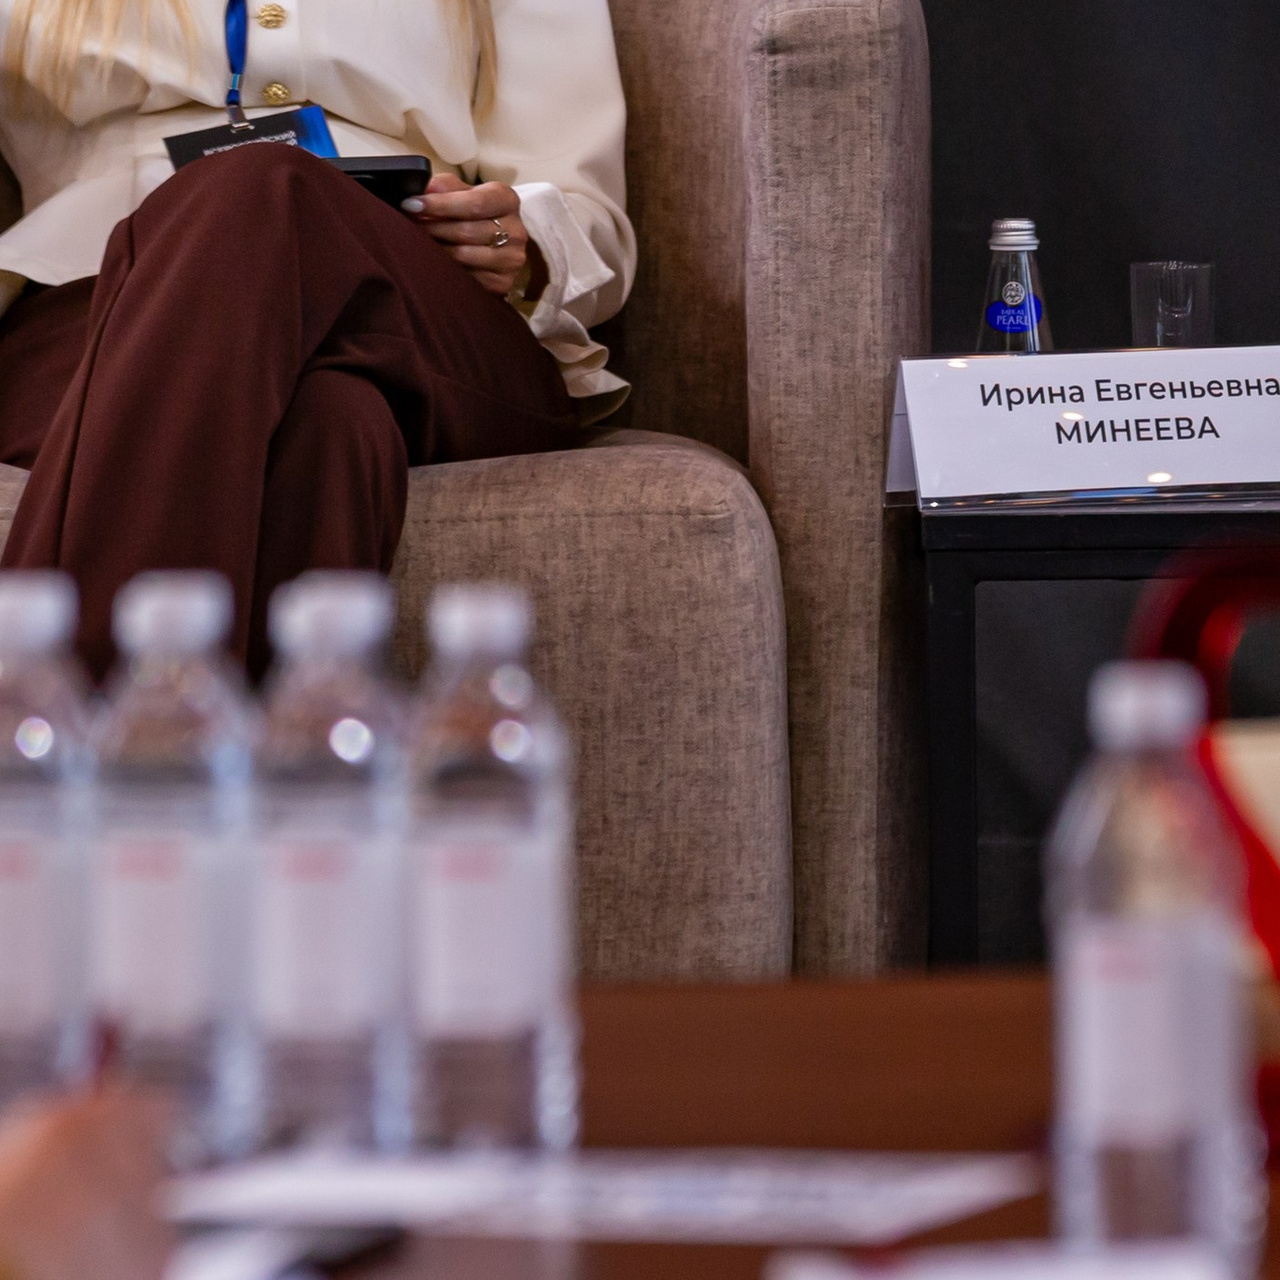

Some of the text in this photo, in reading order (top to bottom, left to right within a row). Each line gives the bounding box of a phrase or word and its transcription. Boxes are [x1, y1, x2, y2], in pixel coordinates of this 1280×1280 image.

[996, 314, 1029, 326] PEARL
[979, 377, 1280, 412] Ирина Евгеньевна
[1055, 415, 1221, 445] МИНЕЕВА
